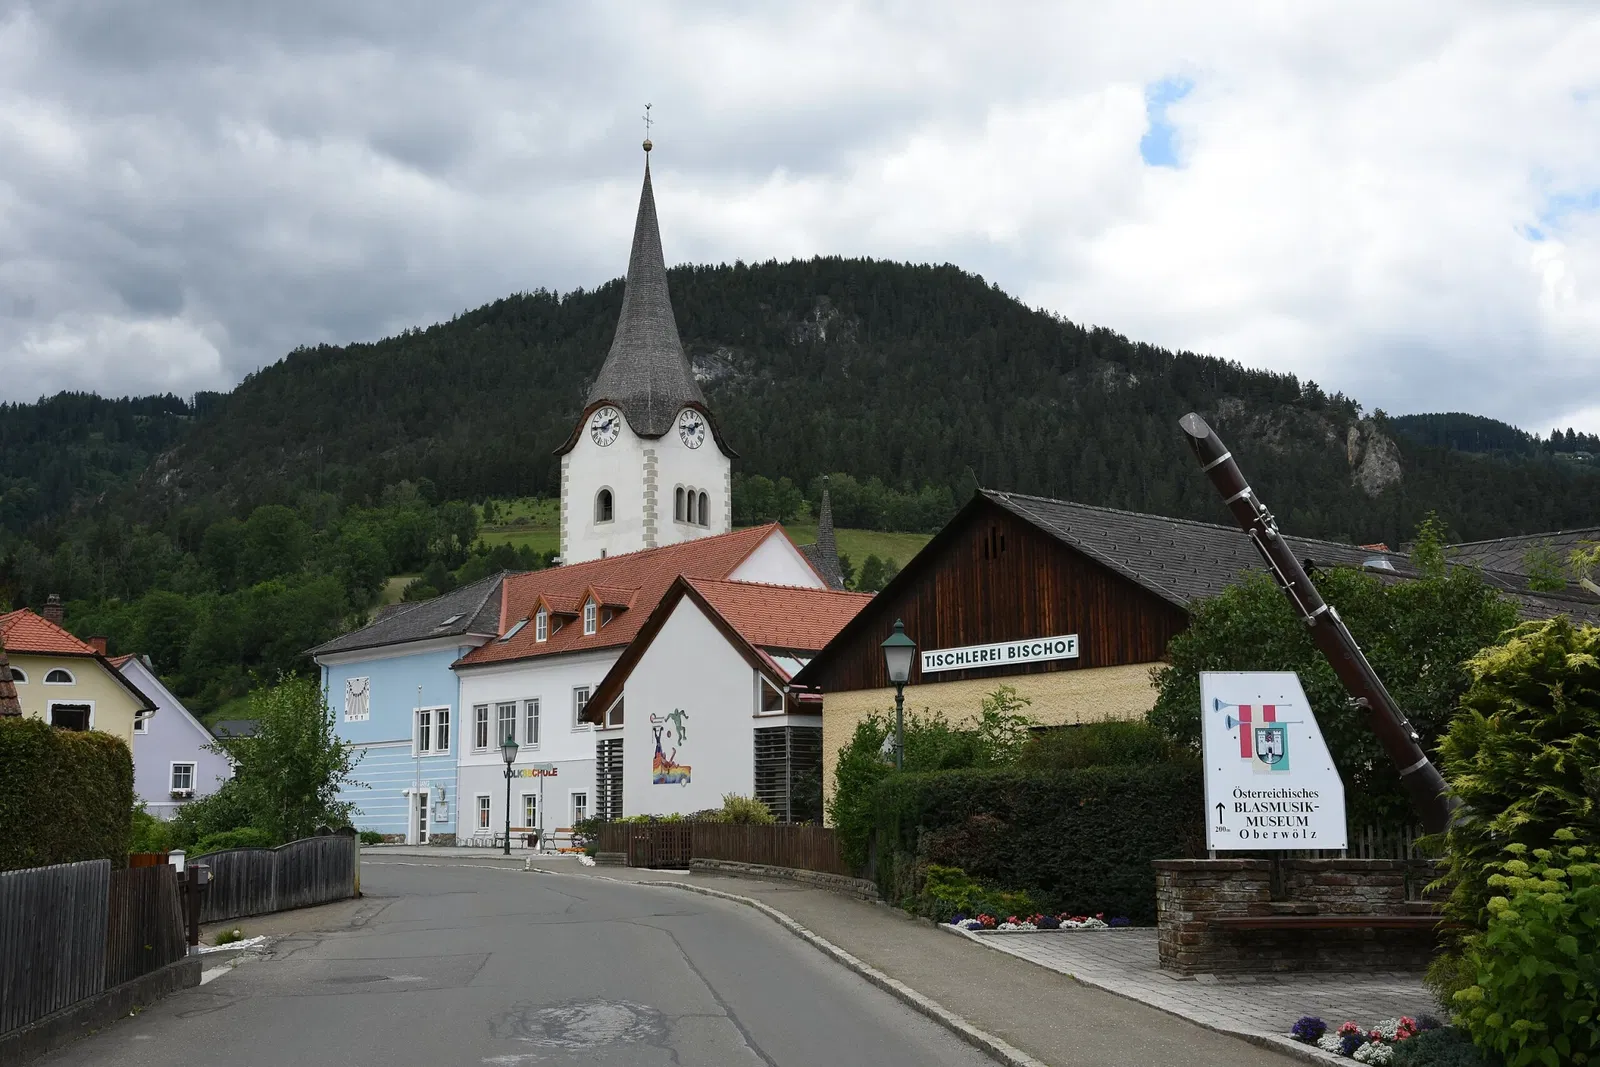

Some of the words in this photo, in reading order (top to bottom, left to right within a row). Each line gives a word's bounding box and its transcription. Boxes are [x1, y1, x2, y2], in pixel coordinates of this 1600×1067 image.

[925, 648, 1000, 667] TISCHLEREI
[1008, 640, 1074, 659] BISCHOF
[1233, 786, 1319, 798] Österreichisches
[1234, 802, 1320, 813] BLASMUSIK-
[1246, 816, 1309, 827] MUSEUM
[1239, 829, 1317, 839] Oberwölz
